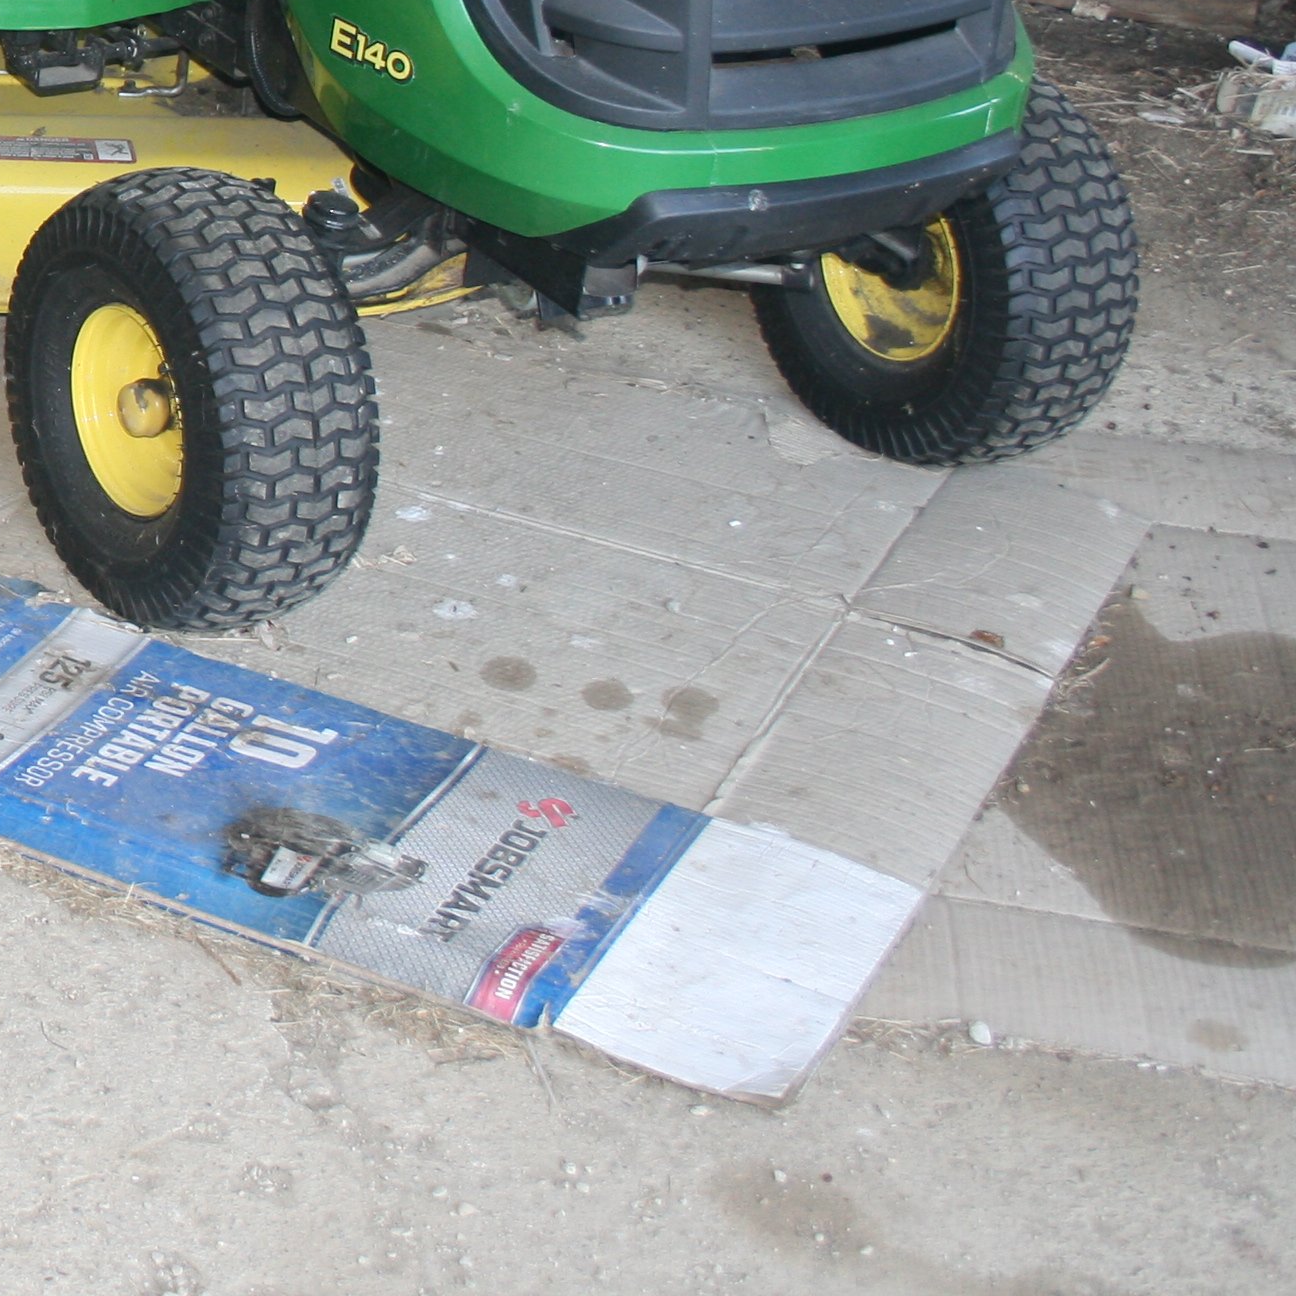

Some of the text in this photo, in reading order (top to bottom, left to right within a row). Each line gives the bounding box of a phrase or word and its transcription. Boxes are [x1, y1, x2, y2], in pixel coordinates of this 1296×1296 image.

[330, 17, 413, 81] E140
[38, 655, 92, 688] 125
[14, 670, 160, 787] AIR COMPRESSOR
[70, 682, 211, 787] PORTABLE
[142, 695, 255, 777] GALLON
[227, 713, 339, 770] 10
[417, 818, 549, 943] JOBSMART
[493, 932, 554, 1000] SATISFACTION
